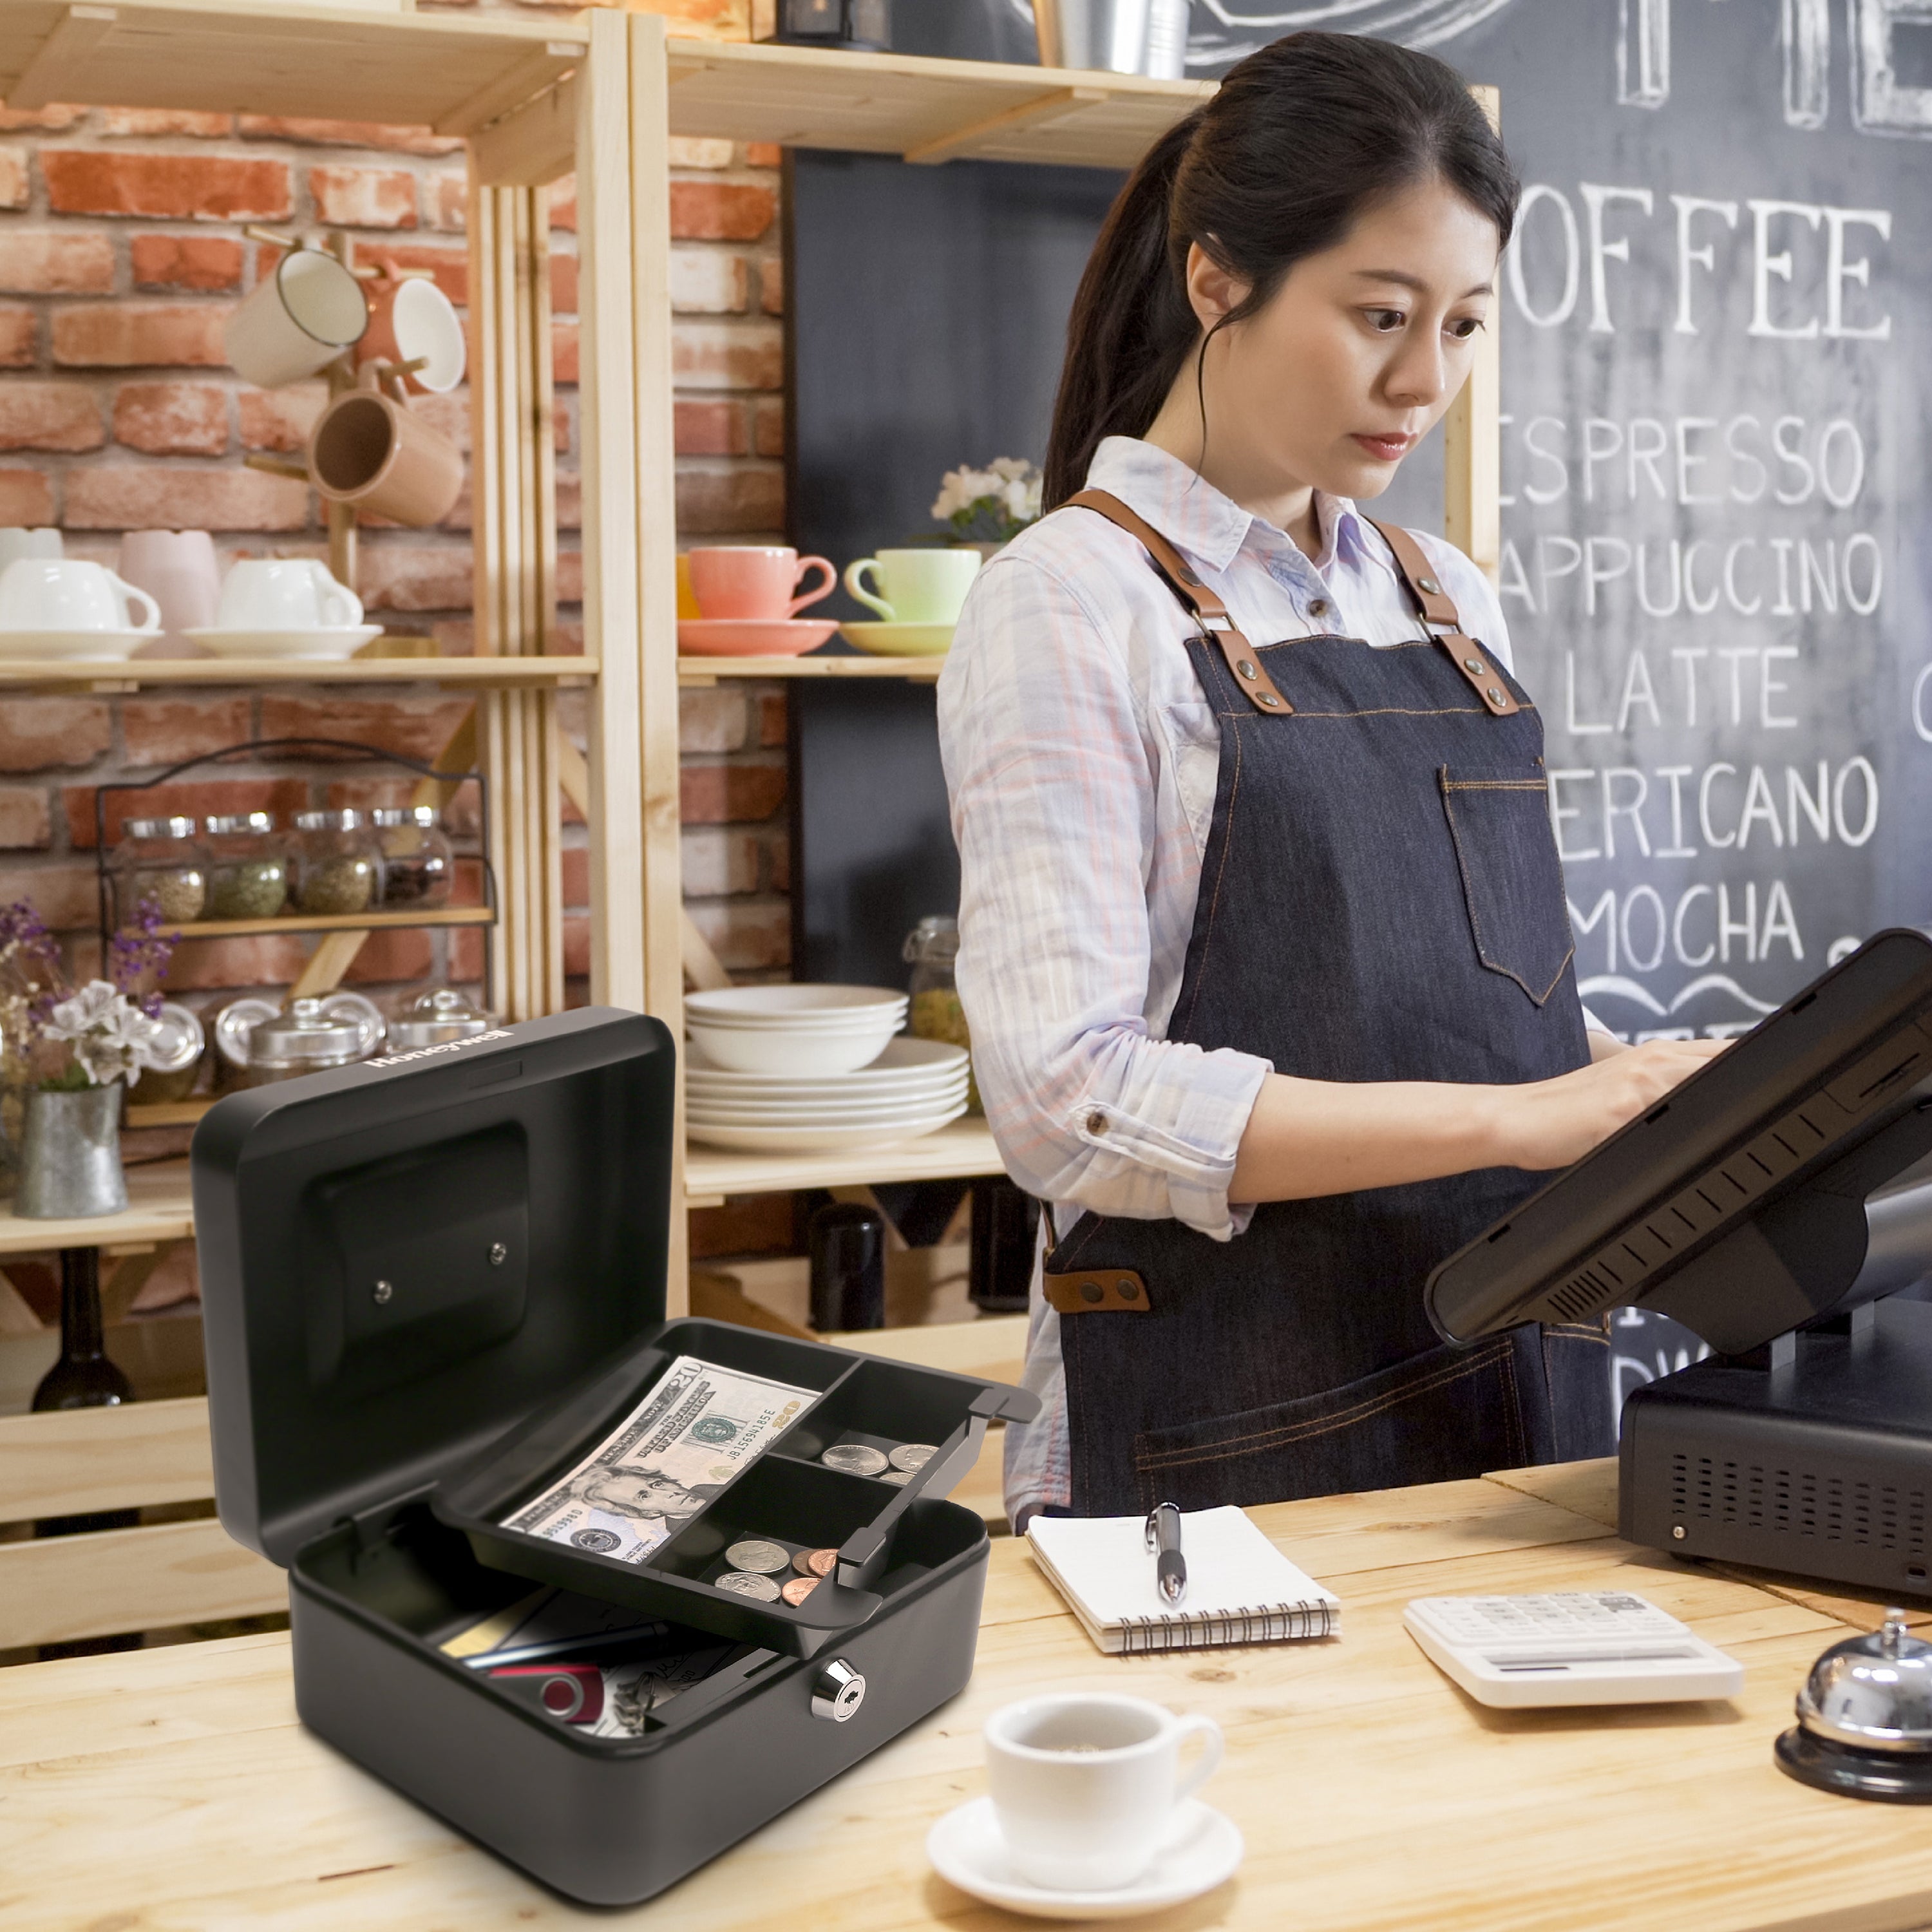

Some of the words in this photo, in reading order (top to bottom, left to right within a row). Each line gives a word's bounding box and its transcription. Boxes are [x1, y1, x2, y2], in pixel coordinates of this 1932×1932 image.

[1566, 647, 1799, 734] LATTE
[1566, 880, 1804, 973] MOCHA
[363, 1029, 515, 1068] Honeywell
[670, 1362, 703, 1390] 20
[772, 1400, 800, 1429] 20
